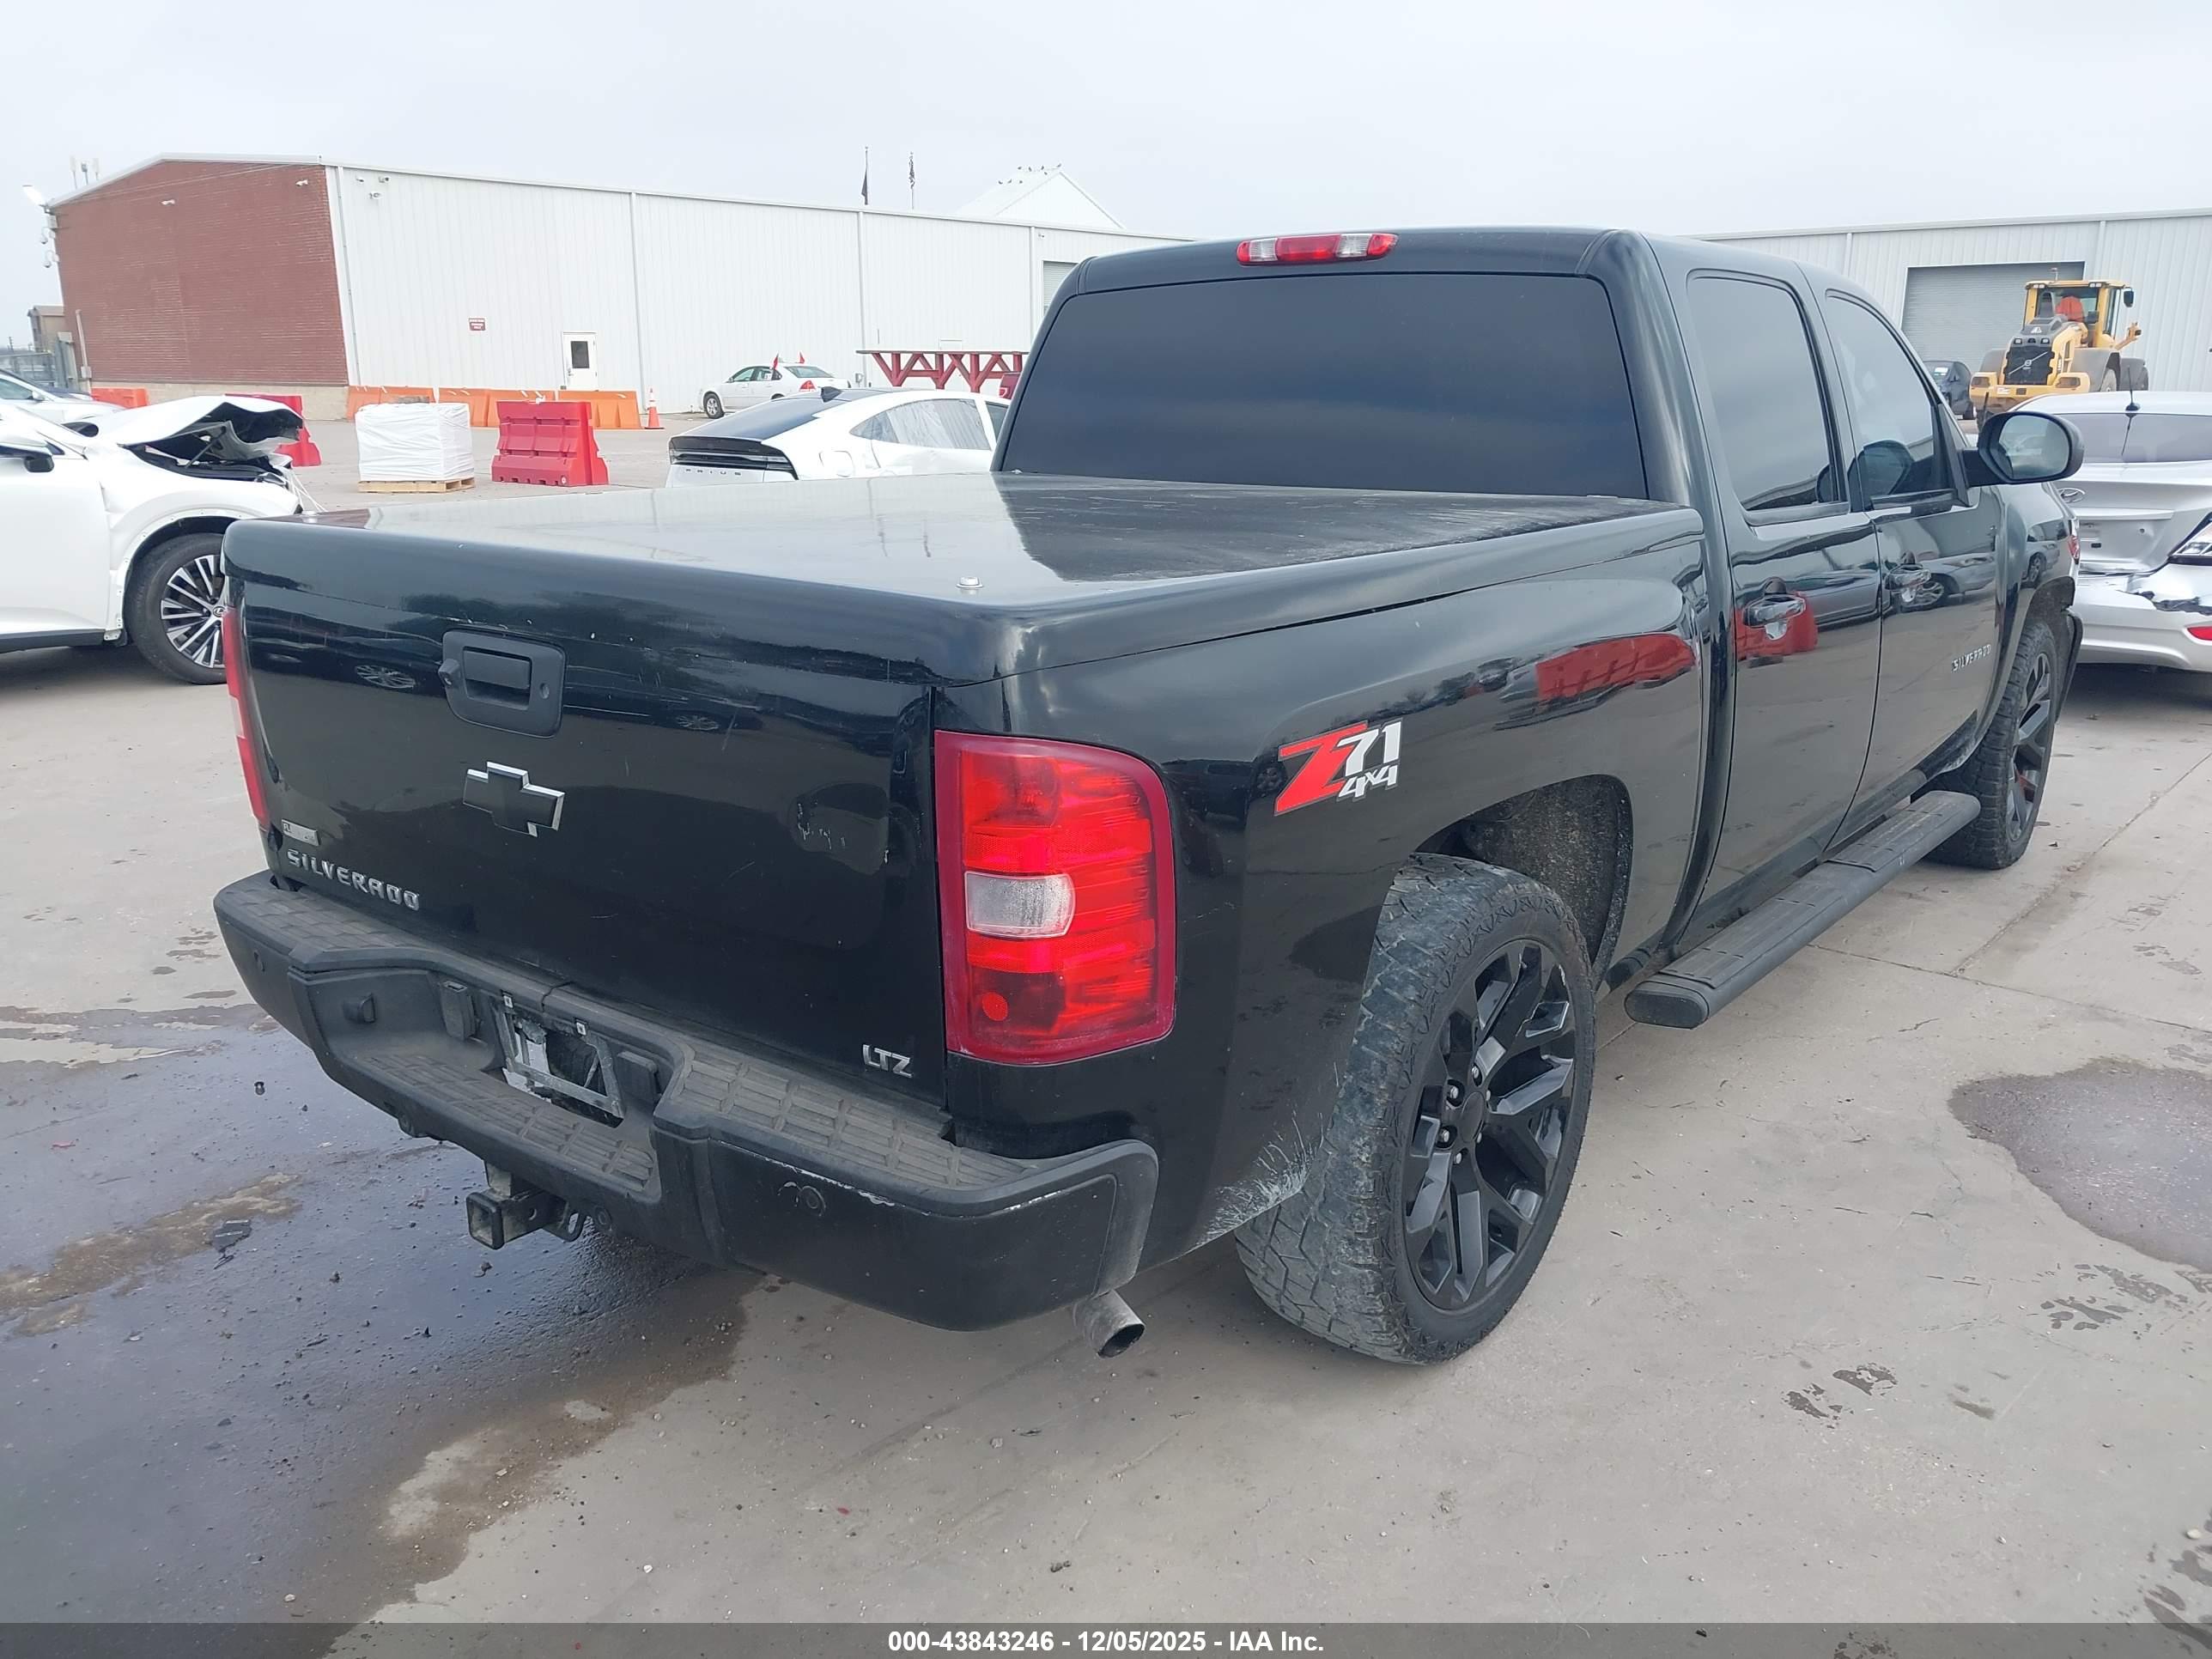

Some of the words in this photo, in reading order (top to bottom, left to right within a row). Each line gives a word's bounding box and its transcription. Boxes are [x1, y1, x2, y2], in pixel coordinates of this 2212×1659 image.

[1274, 718, 1402, 816] Z71
[287, 848, 420, 911] SILVERADO
[862, 1043, 913, 1079] LTZ
